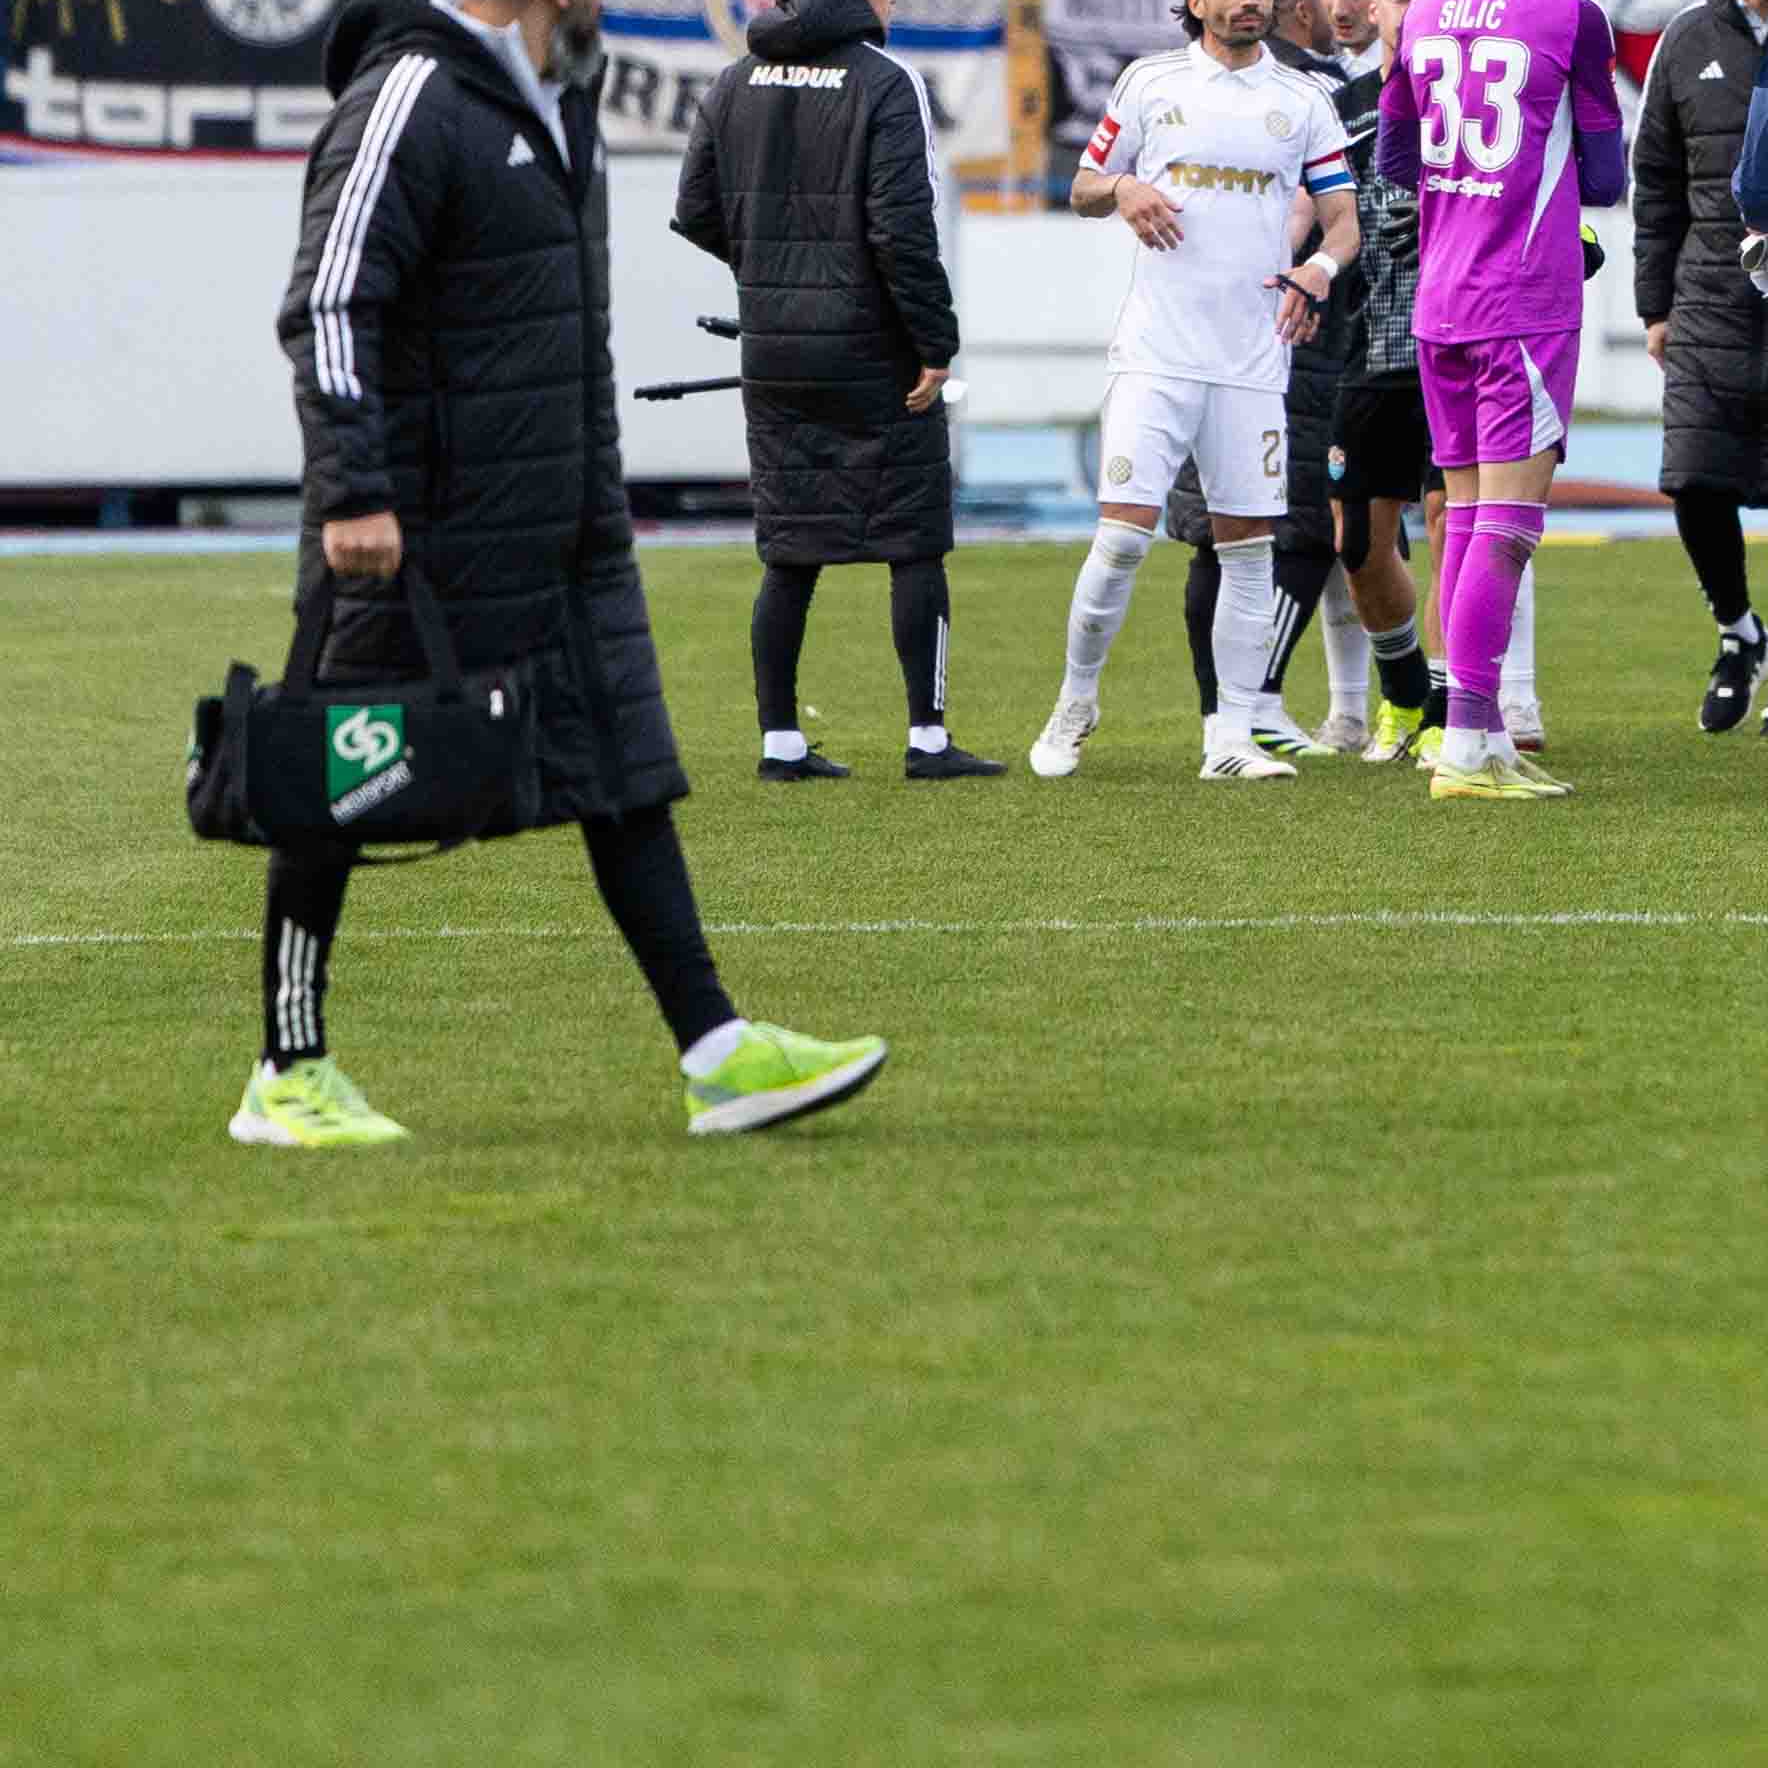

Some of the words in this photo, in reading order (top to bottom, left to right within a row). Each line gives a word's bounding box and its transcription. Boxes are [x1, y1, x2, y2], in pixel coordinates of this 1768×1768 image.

[748, 64, 849, 89] HAJDUK
[1411, 35, 1531, 173] 33
[1165, 162, 1276, 196] TOMMY
